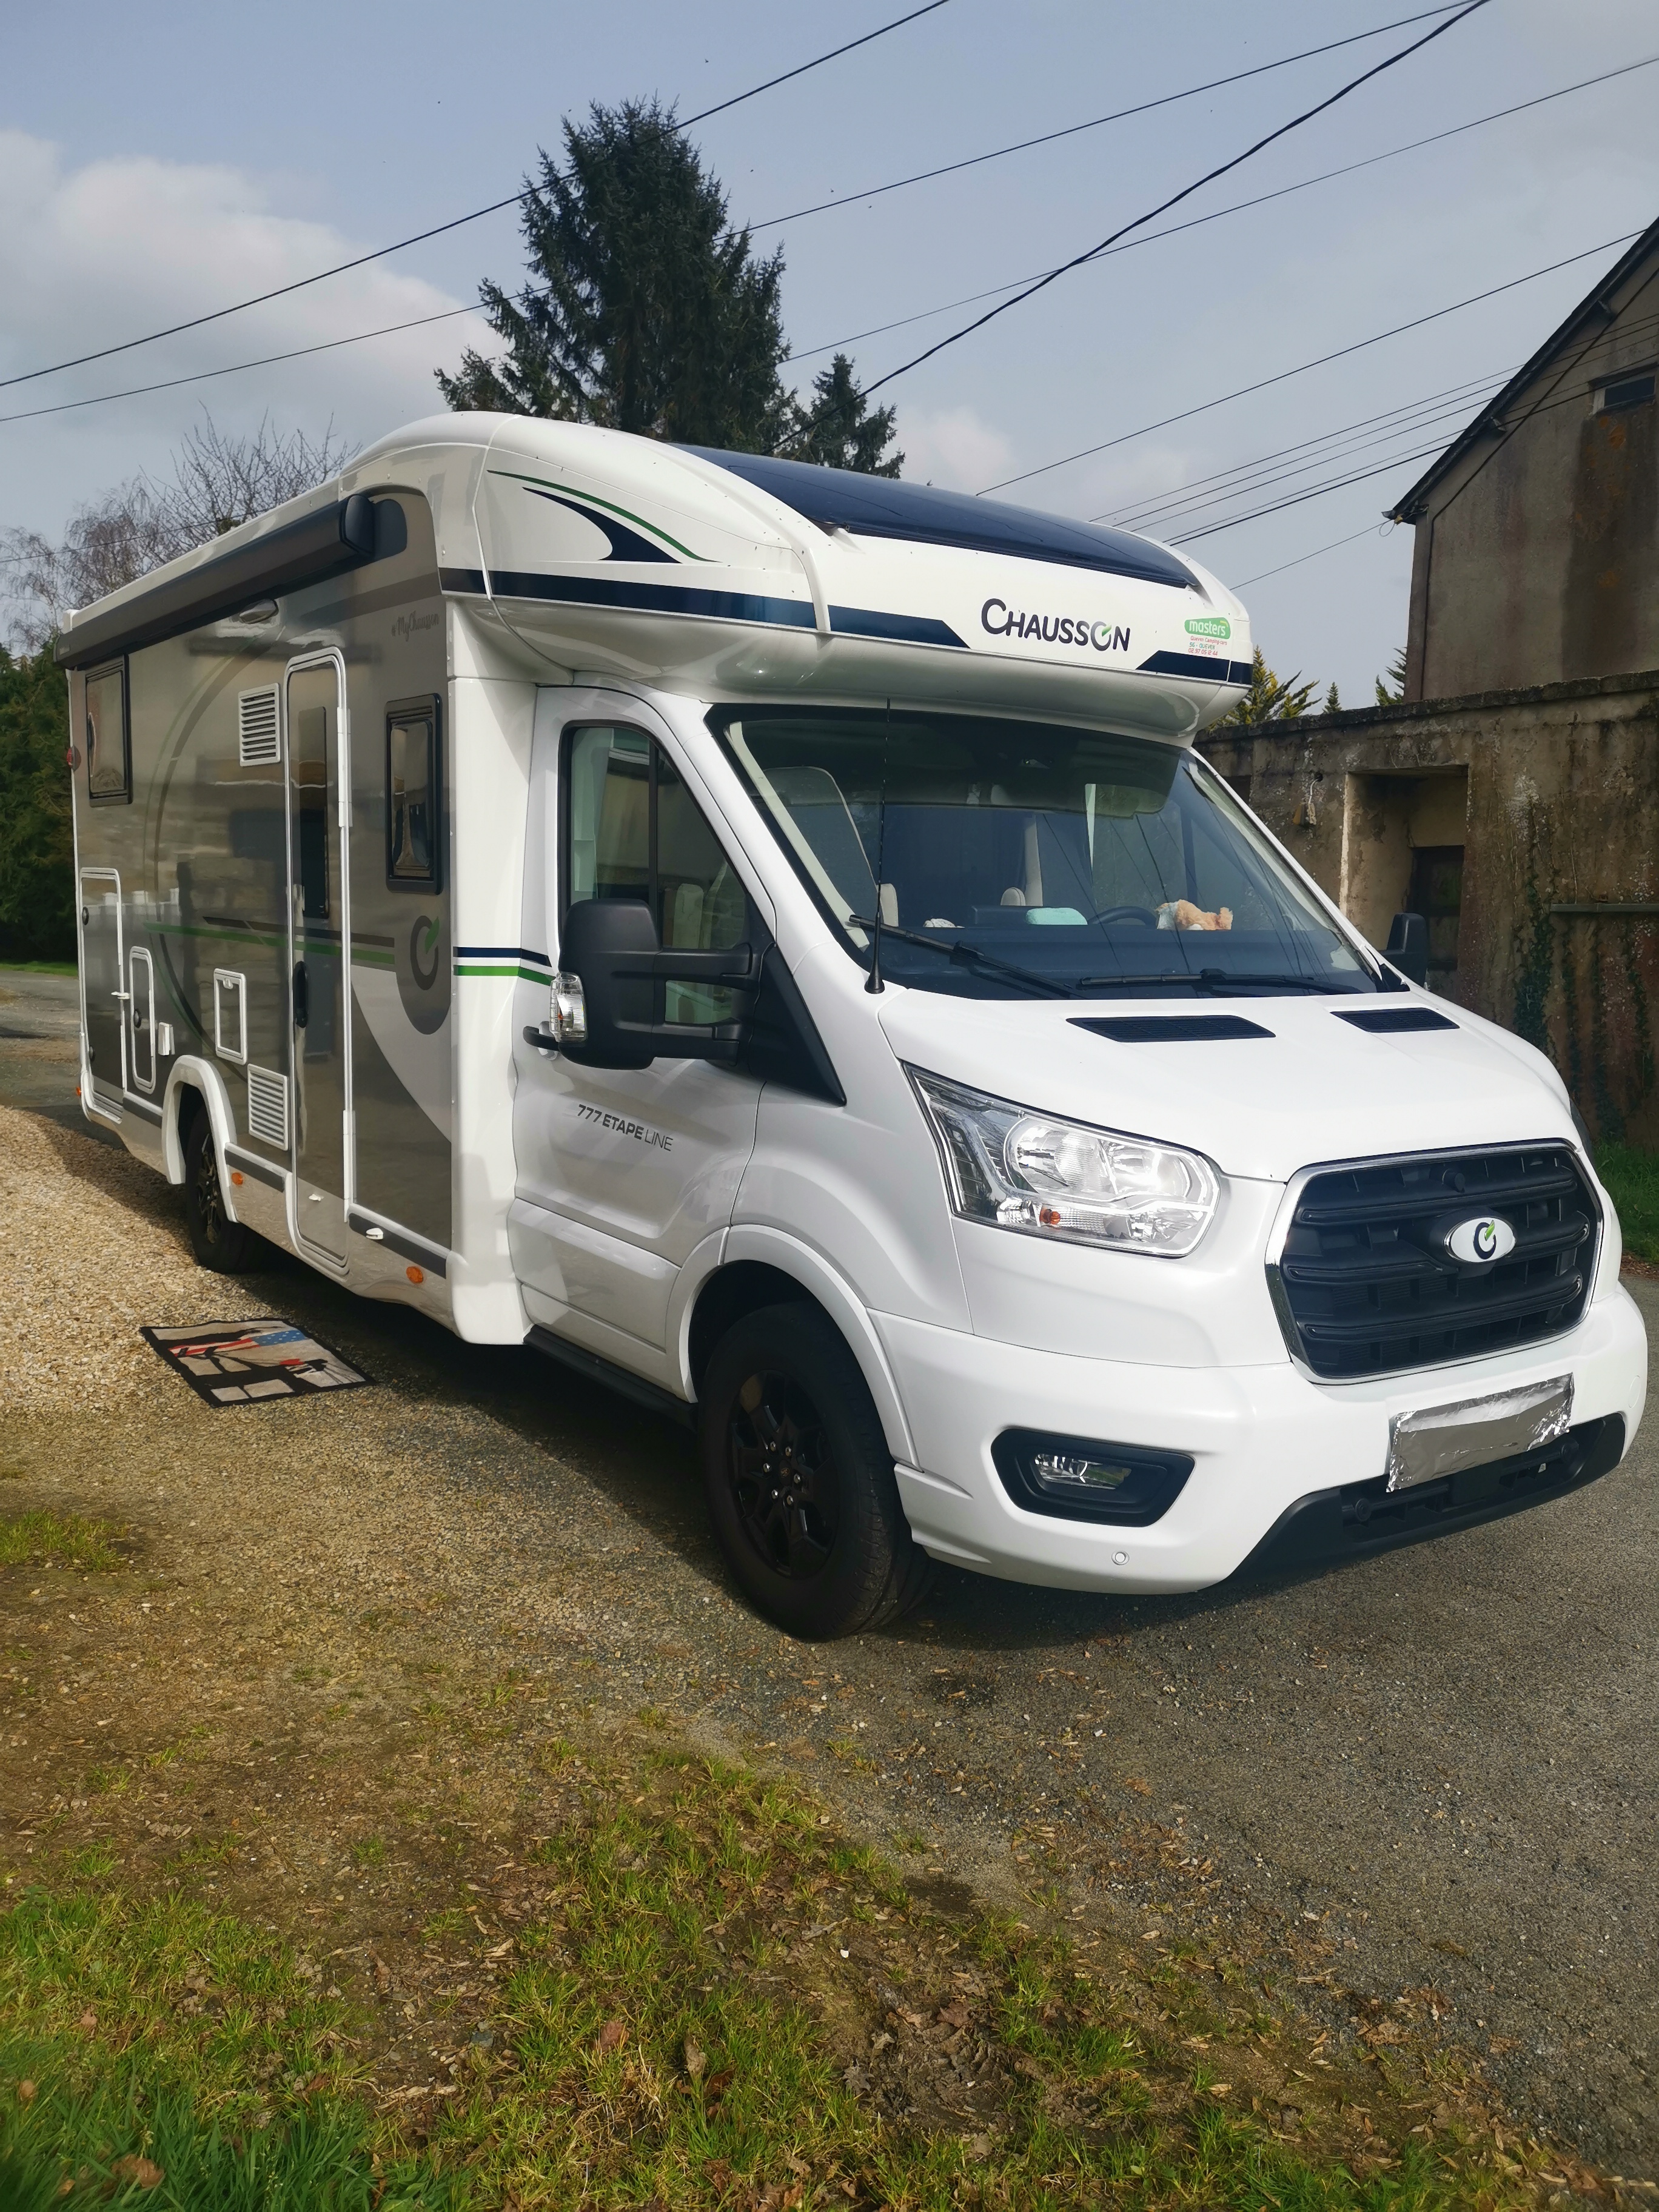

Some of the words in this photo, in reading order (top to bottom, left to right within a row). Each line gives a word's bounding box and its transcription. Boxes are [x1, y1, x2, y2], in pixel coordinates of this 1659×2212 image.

[981, 598, 1130, 651] CHAUSSON
[1189, 621, 1225, 636] masters
[578, 1104, 602, 1122] 777
[603, 1114, 644, 1140] ETAPE
[645, 1129, 673, 1151] LINE
